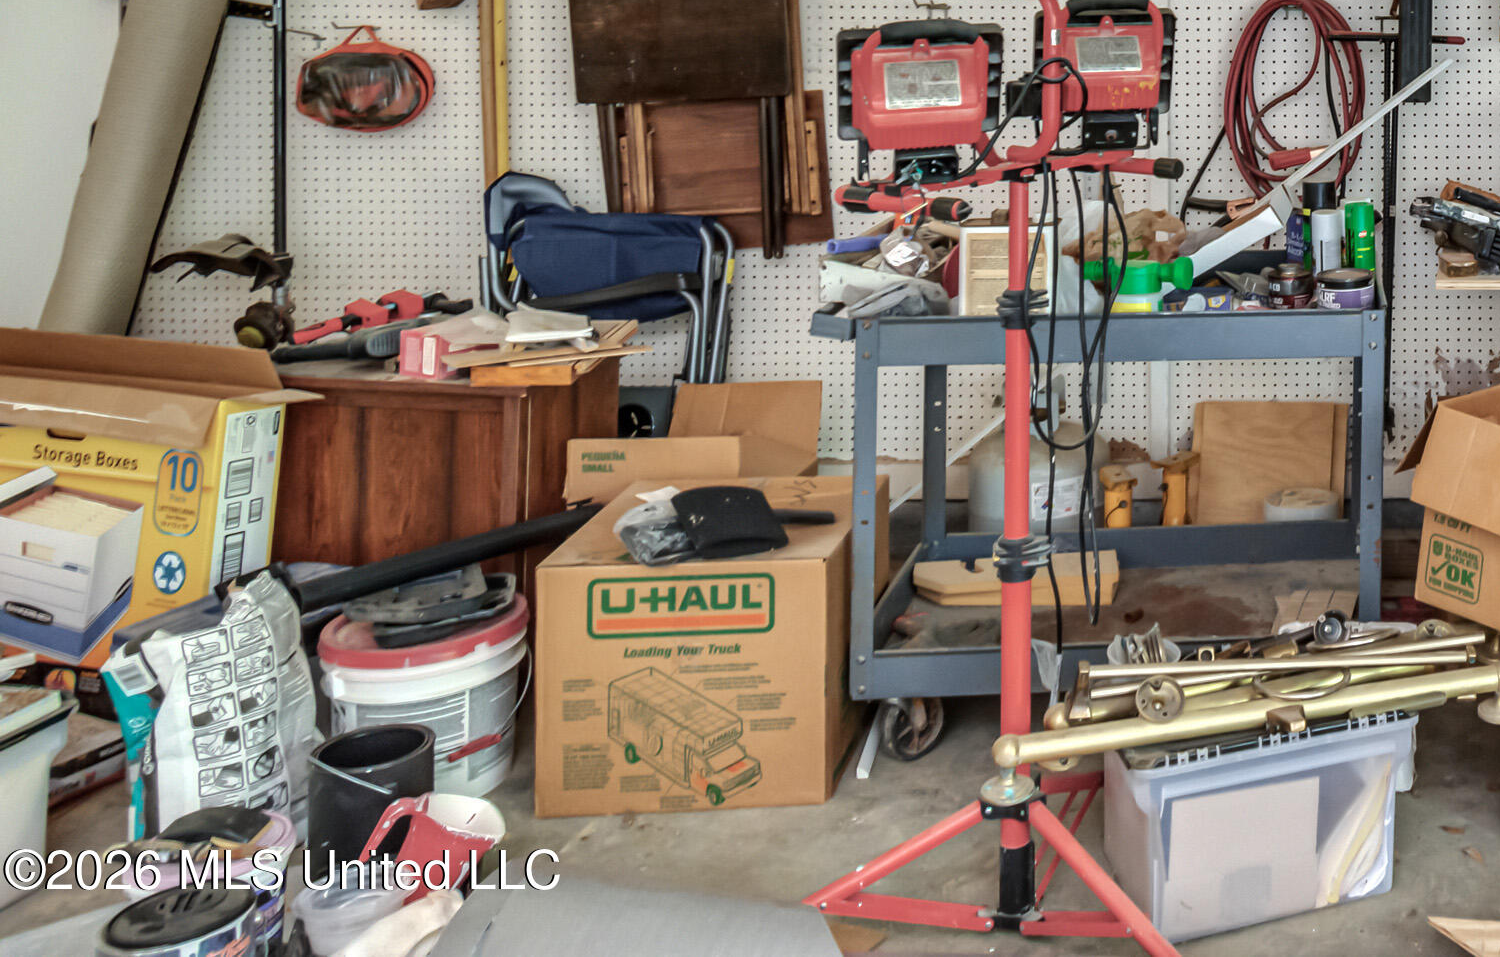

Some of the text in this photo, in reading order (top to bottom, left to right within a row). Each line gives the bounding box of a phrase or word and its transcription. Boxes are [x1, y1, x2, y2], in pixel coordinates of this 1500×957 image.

[32, 444, 138, 471] Storage Boxes
[581, 463, 614, 473] SMALL
[167, 454, 198, 493] 10
[1445, 570, 1476, 590] OK
[601, 583, 763, 614] U-HAUL
[623, 643, 741, 659] Loading Your Truck
